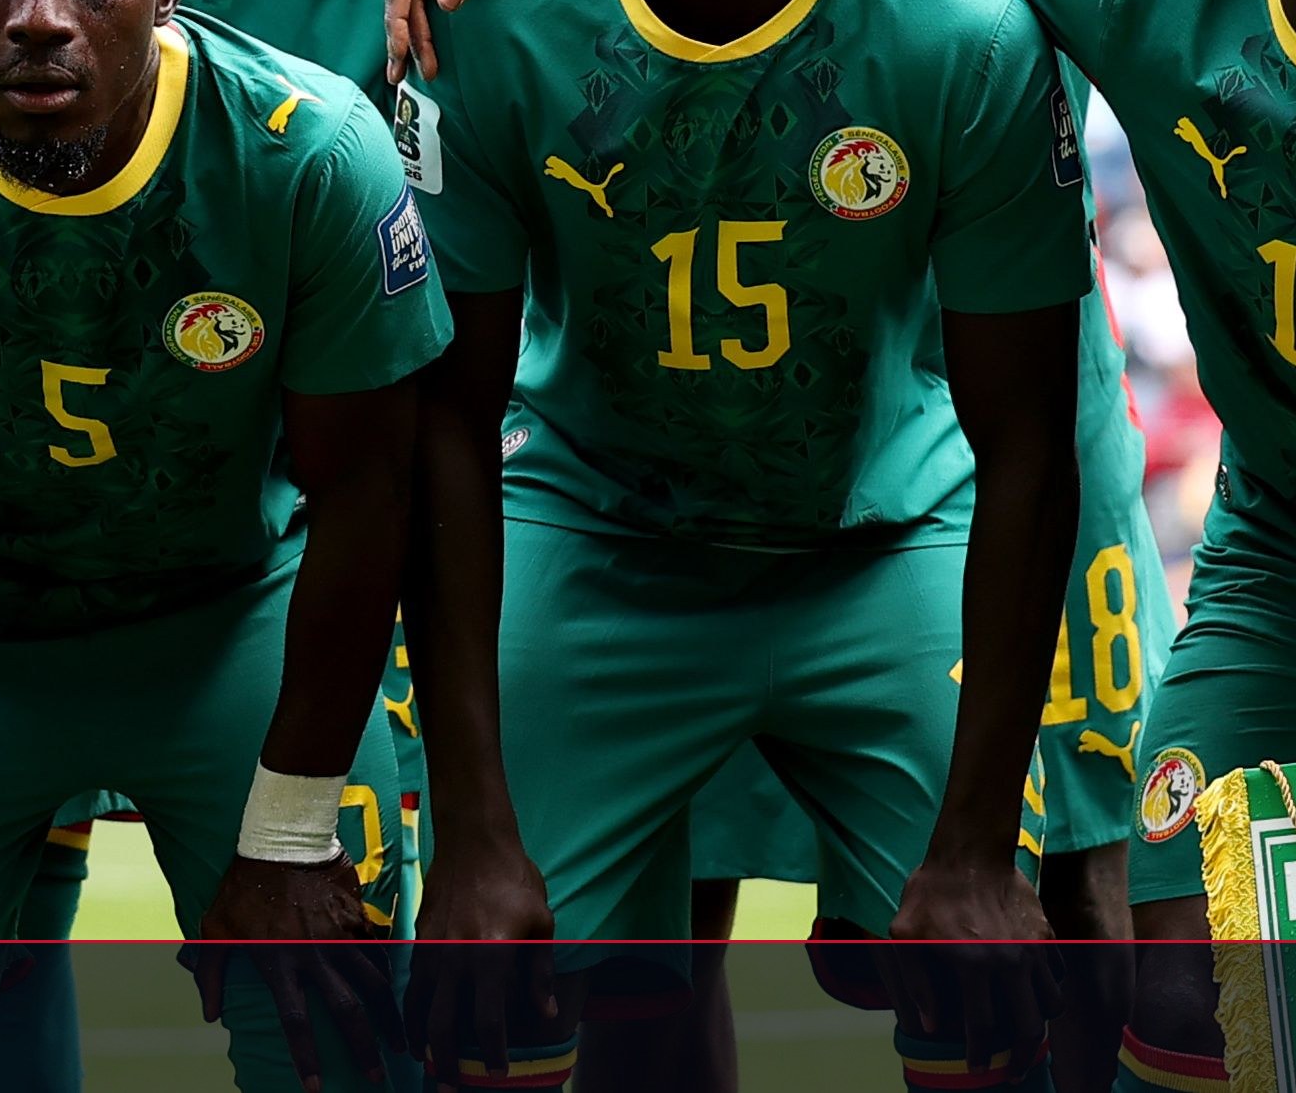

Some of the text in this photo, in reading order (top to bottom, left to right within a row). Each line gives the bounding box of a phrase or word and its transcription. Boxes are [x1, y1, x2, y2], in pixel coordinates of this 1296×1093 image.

[843, 200, 894, 216] FOOTBALL
[650, 220, 791, 370] 15
[41, 359, 118, 468] 5
